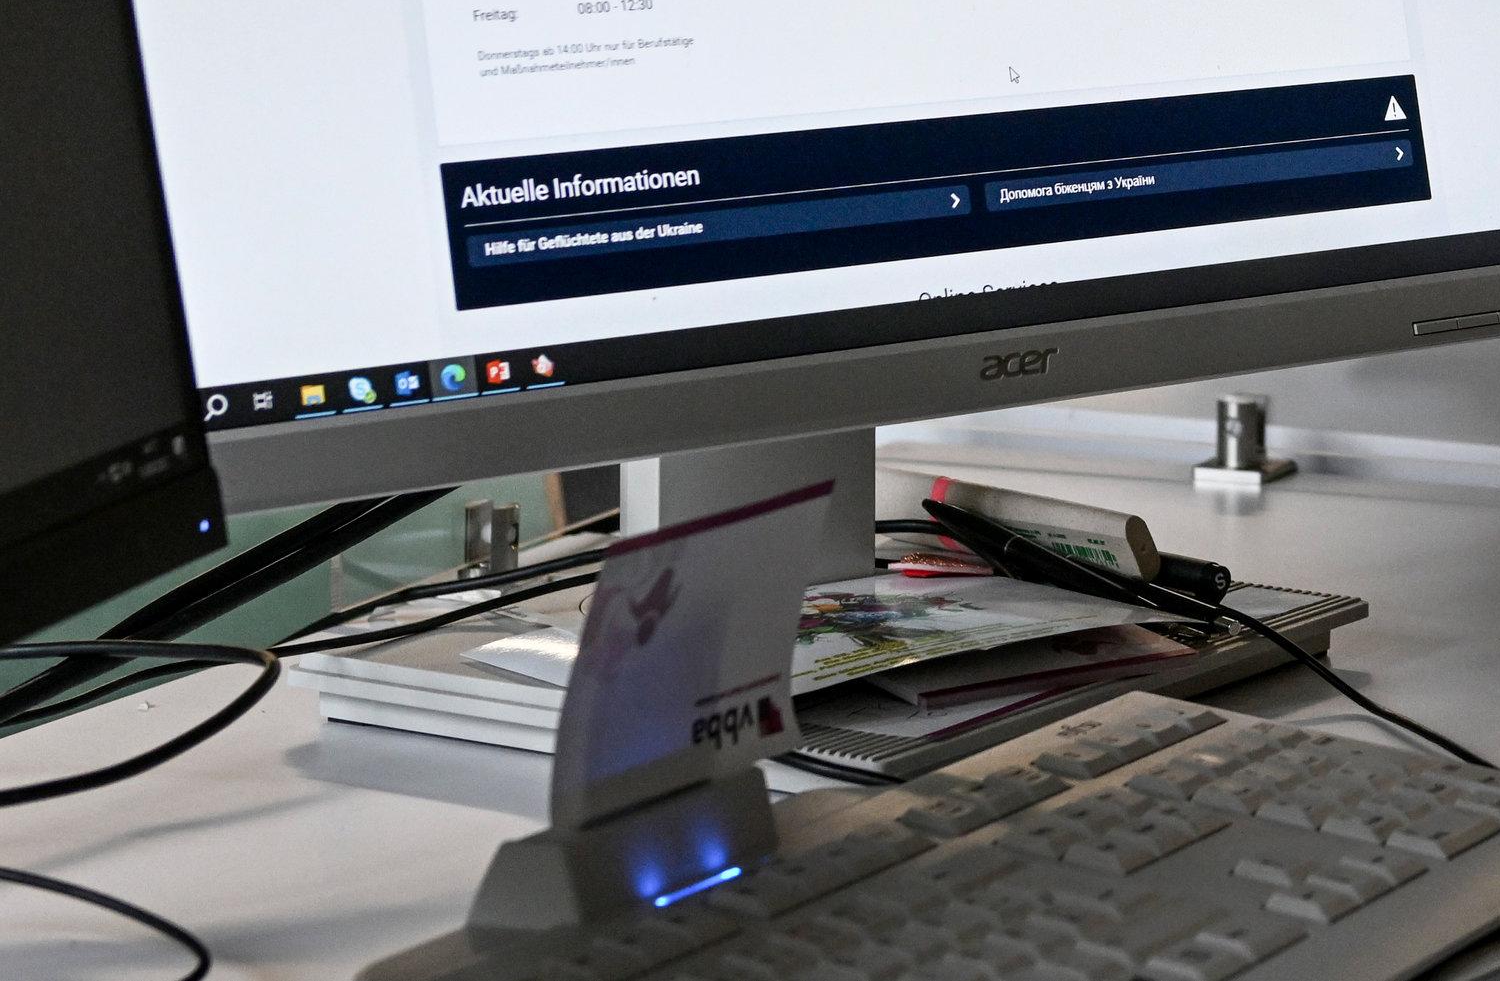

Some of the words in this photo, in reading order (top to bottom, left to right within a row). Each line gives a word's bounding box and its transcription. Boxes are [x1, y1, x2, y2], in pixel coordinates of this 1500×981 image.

[577, 1, 610, 15] 08:00
[477, 47, 540, 62] Donnerstags
[587, 42, 602, 53] Uhr
[605, 43, 620, 52] nur
[622, 39, 635, 50] für
[480, 67, 499, 77] und
[461, 177, 549, 209] Aktuelle
[553, 167, 701, 201] Informationen
[1000, 184, 1053, 204] Допомога
[1055, 179, 1105, 197] біженцям
[1106, 180, 1113, 190] з
[1115, 173, 1155, 190] України
[484, 239, 516, 257] Hilfe
[518, 237, 536, 253] für
[538, 230, 608, 251] Geflüchtete
[611, 229, 633, 242] aus
[635, 226, 656, 240] der
[658, 220, 703, 239] Ukraine
[980, 347, 1060, 380] acer
